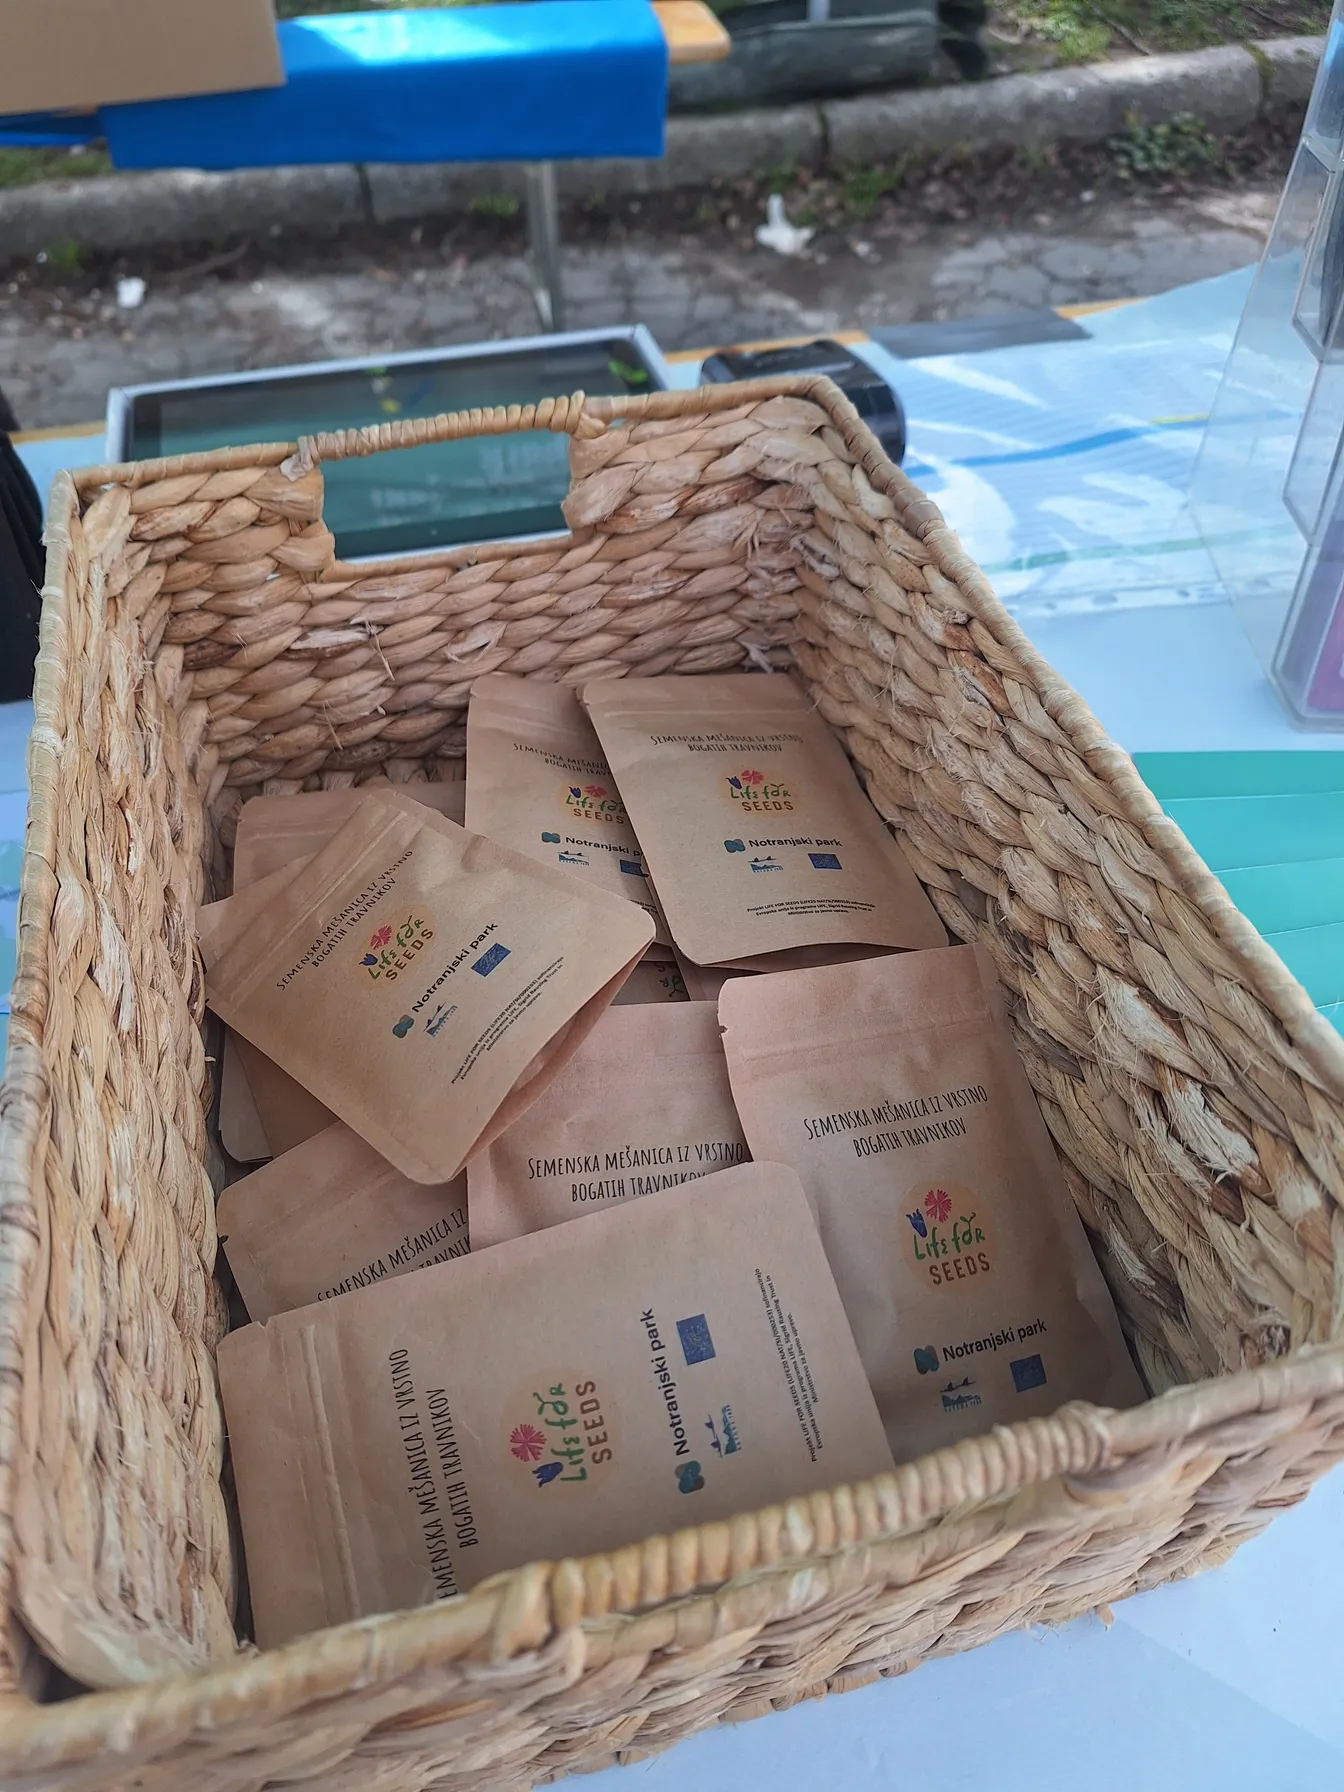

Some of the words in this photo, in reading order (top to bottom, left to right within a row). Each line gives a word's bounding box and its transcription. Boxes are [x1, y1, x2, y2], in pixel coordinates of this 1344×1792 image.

[513, 743, 564, 761] SEMENSKA
[650, 735, 705, 746] SEMENSKA
[688, 743, 727, 751] BOGATIH
[728, 743, 783, 751] TRAVNIKOV
[544, 758, 582, 773] BOGATIH
[573, 808, 625, 825] SEEDS
[741, 800, 794, 811] SEEDS
[565, 836, 629, 854] Notranjski
[748, 837, 813, 848] Notranjski
[815, 838, 843, 848] park
[276, 939, 324, 991] SEMENSKA
[322, 893, 369, 938] MEŠANICA
[367, 881, 379, 892] IZ
[377, 850, 413, 881] VRSTNO
[311, 928, 348, 968] BOGATIH
[345, 877, 396, 927] TRAVNIKOV
[385, 928, 434, 980] SEEDS
[411, 948, 470, 1013] Notranjski
[470, 923, 498, 950] park
[803, 1109, 873, 1141] SEMENSKA
[870, 1099, 931, 1125] MEŠANICA
[928, 1096, 944, 1114] IZ
[942, 1085, 989, 1110] VRSTNO
[852, 1131, 903, 1158] BOGATIH
[900, 1117, 968, 1147] TRAVNIKOV
[528, 1154, 600, 1180] SEMENSKA
[605, 1144, 674, 1172] MEŠANICA
[677, 1145, 690, 1163] IZ
[694, 1141, 744, 1163] VRSTNO
[571, 1180, 626, 1203] BOGATIH
[387, 1218, 453, 1269] MEŠANICA
[450, 1208, 467, 1229] IZ
[929, 1252, 991, 1285] SEEDS
[768, 1281, 776, 1299] Trust
[640, 1308, 666, 1352] park
[780, 1324, 791, 1344] Sigrid
[942, 1326, 1015, 1362] Notranjski
[1016, 1318, 1048, 1344] park
[389, 1349, 415, 1410] VRSTNO
[793, 1360, 807, 1393] programa
[803, 1365, 819, 1403] Ministrstvo
[651, 1356, 690, 1456] Notranjski
[790, 1385, 800, 1407] SEEDS
[805, 1400, 814, 1418] unija
[399, 1413, 420, 1430] IZ
[575, 1380, 612, 1464] SEEDS
[796, 1406, 805, 1421] FOR
[801, 1421, 809, 1437] LIFE
[425, 1389, 462, 1479] TRAVNIKOV
[806, 1435, 817, 1462] Projekt
[810, 1418, 823, 1450] Evropska
[403, 1432, 439, 1515] MEŠANICA
[446, 1481, 479, 1548] BOGATIH
